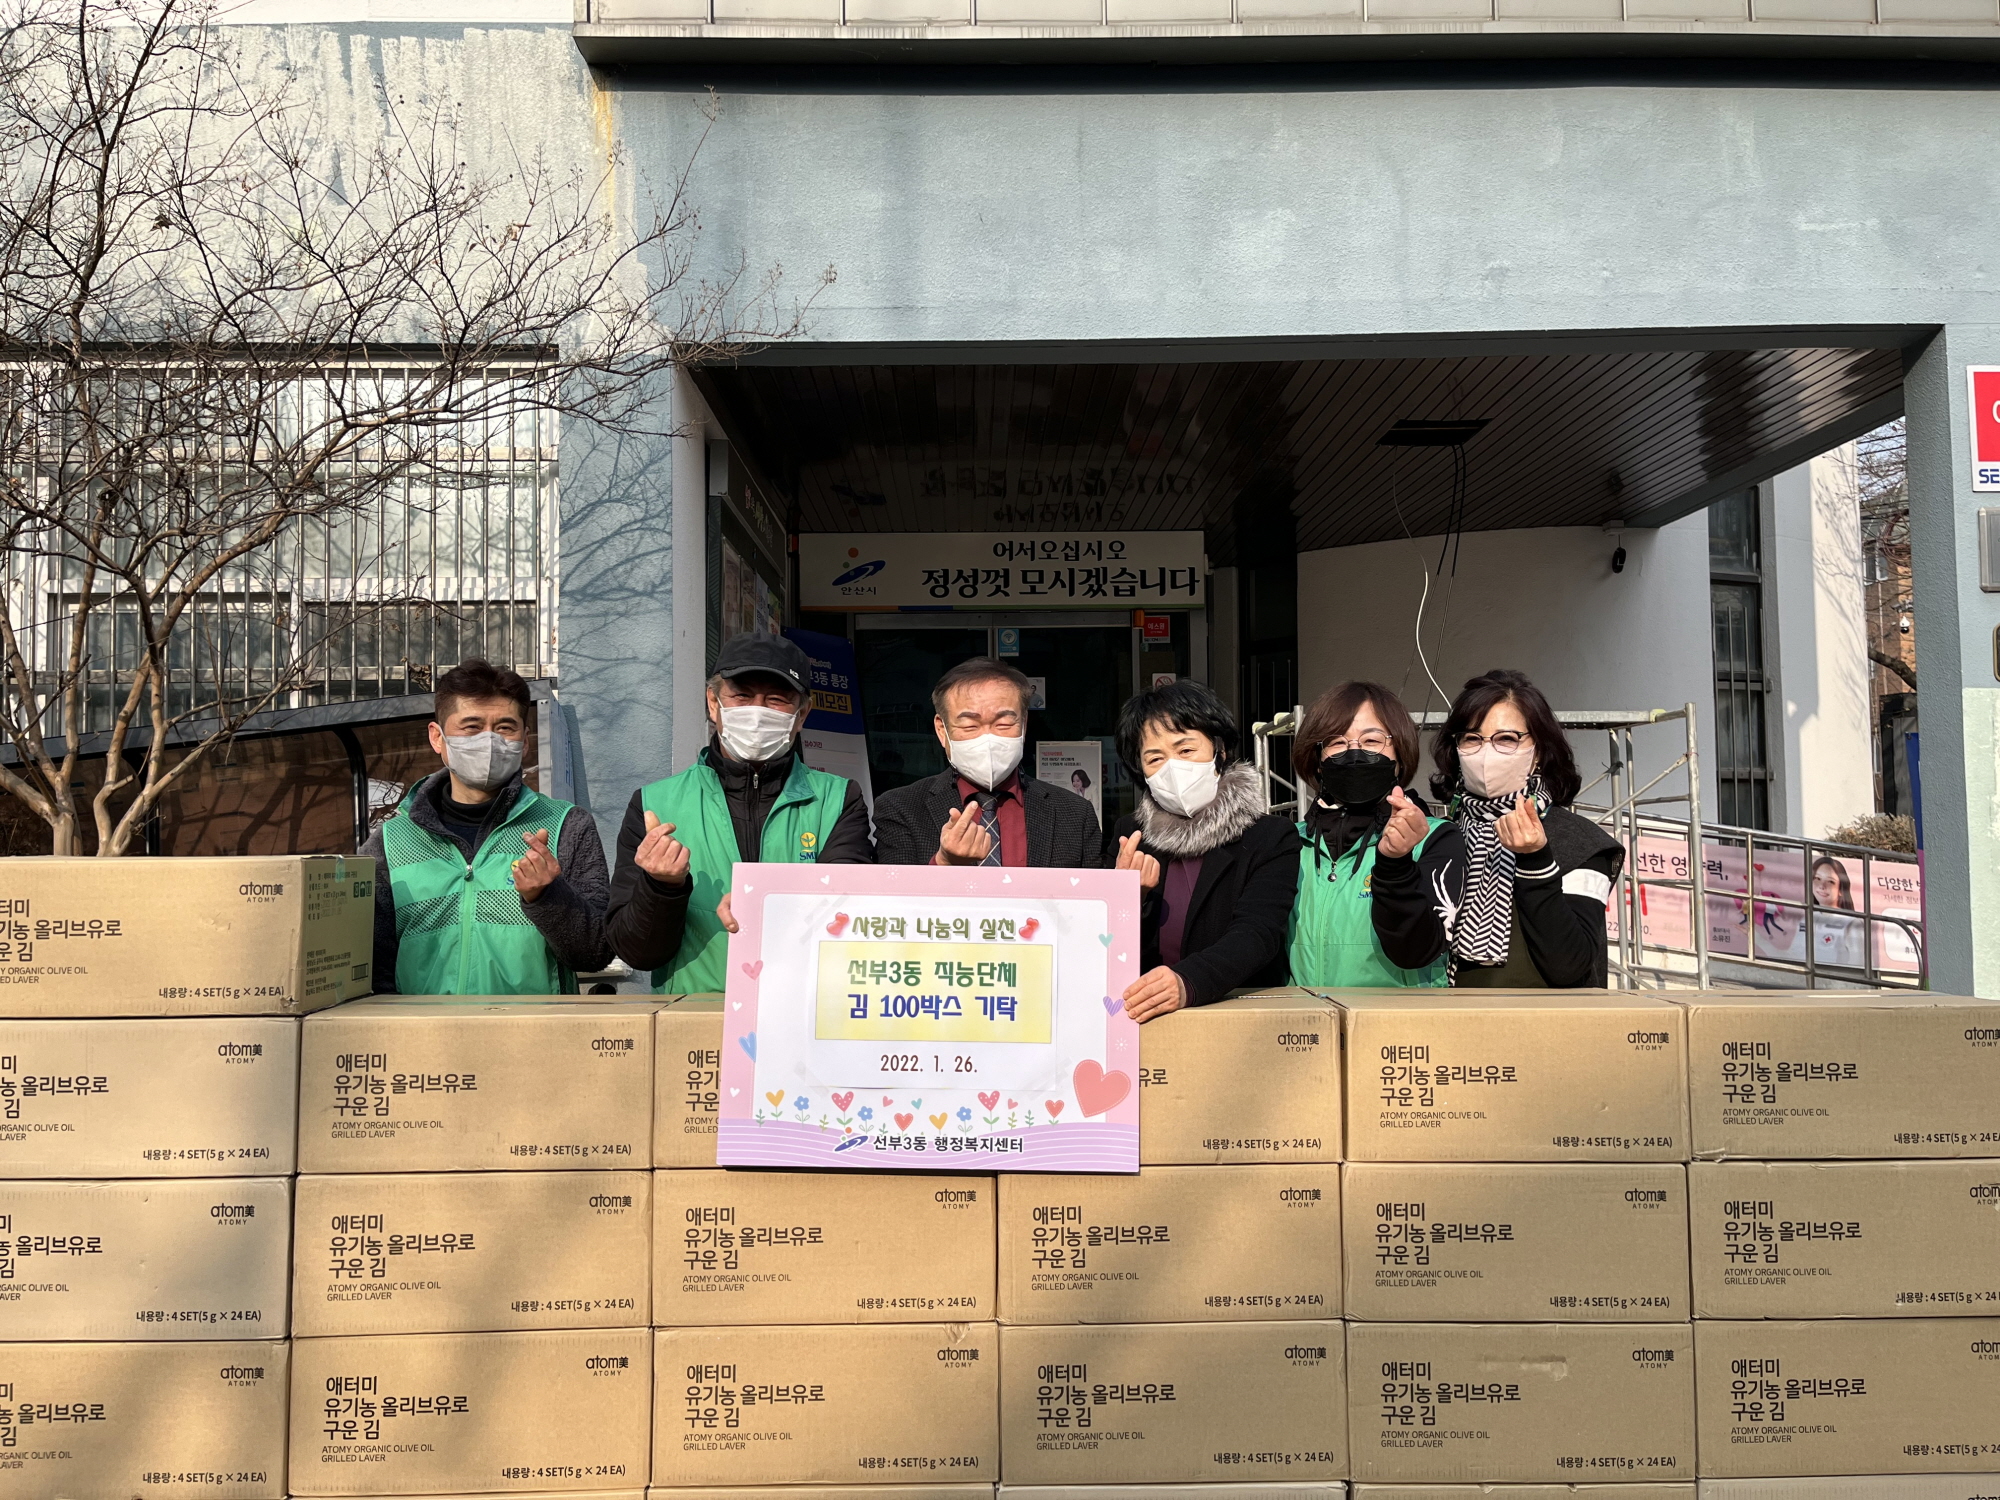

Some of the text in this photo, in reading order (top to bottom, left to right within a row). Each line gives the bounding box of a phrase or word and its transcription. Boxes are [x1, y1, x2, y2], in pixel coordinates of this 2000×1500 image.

[993, 540, 1127, 562] 어서오십시오
[841, 586, 877, 596] 안산시
[921, 566, 1201, 598] 정성껏 모시겠습니다
[830, 673, 849, 690] 통장
[812, 691, 849, 712] 개모집
[1671, 856, 1729, 881] 영력,
[1877, 876, 1914, 893] 다양한
[852, 917, 1014, 940] 사랑과 나눔의 실천
[1712, 934, 1731, 944] 소유진
[847, 960, 1016, 987] 선부3동 직능단체
[848, 994, 1018, 1021] 김 100박스 기탁
[1381, 1045, 1429, 1064] 애터미
[1722, 1042, 1771, 1060] 애터미
[336, 1053, 386, 1073] 애터미
[881, 1054, 977, 1073] 2022. 1. 26.
[1721, 1062, 1858, 1082] 유기농 올리브유로
[334, 1074, 477, 1095] 유기농 올리브유로
[1380, 1065, 1517, 1086] 유기농 올리브유로
[1380, 1087, 1433, 1107] 구운 김
[1722, 1084, 1776, 1103] 구운 김
[333, 1096, 389, 1116] 구운 김
[1410, 1111, 1446, 1119] ORGANIC
[331, 1130, 395, 1138] GRILLED LAVER
[364, 1121, 401, 1129] ORGANIC
[430, 1120, 443, 1128] OIL
[1380, 1120, 1441, 1128] GRILLED LAVER
[510, 1145, 538, 1156] 내용량
[544, 1146, 551, 1155] 4
[552, 1145, 580, 1156] SET(5
[582, 1147, 588, 1157] g
[602, 1145, 614, 1154] 24
[616, 1144, 631, 1156] EA)
[873, 1136, 1022, 1153] 선부3동 행정복지센터
[686, 1207, 734, 1226] 애터미
[1033, 1206, 1081, 1225] 애터미
[1376, 1202, 1425, 1221] 애터미
[1724, 1201, 1773, 1219] 애터미
[332, 1214, 383, 1234] 애터미
[1723, 1221, 1862, 1242] 유기농 올리브유로
[329, 1233, 475, 1256] 유기농 올리브유로
[684, 1227, 824, 1248] 유기농 올리브유로
[1031, 1225, 1170, 1247] 유기농 올리브유로
[684, 1249, 738, 1270] 구운 김
[1032, 1248, 1085, 1269] 구운 김
[1376, 1245, 1429, 1265] 구운 김
[1724, 1243, 1778, 1263] 구운 김
[329, 1257, 386, 1279] 구운 김
[682, 1283, 745, 1292] GRILLED LAVER
[683, 1275, 712, 1283] ATOMY
[714, 1275, 749, 1283] ORGANIC
[752, 1274, 776, 1282] OLIVE
[687, 1364, 736, 1384] 애터미
[1038, 1364, 1087, 1383] 애터미
[1382, 1362, 1431, 1381] 애터미
[1731, 1359, 1780, 1378] 애터미
[326, 1376, 377, 1396] 애터미
[685, 1384, 825, 1406] 유기농 올리브유로
[1037, 1384, 1176, 1406] 유기농 올리브유로
[1381, 1383, 1521, 1404] 유기농 올리브유로
[1730, 1378, 1867, 1400] 유기농 올리브유로
[324, 1396, 469, 1418] 유기농 올리브유로
[1381, 1405, 1435, 1426] 구운 김
[1731, 1401, 1784, 1422] 구운 김
[685, 1407, 739, 1428] 구운 김
[1037, 1407, 1091, 1428] 구운 김
[323, 1419, 379, 1440] 구운 김
[1037, 1433, 1065, 1441] ATOMY
[1067, 1432, 1103, 1441] ORGANIC
[1105, 1432, 1129, 1440] OLIVE
[1037, 1441, 1098, 1450] GRILLED LAVER
